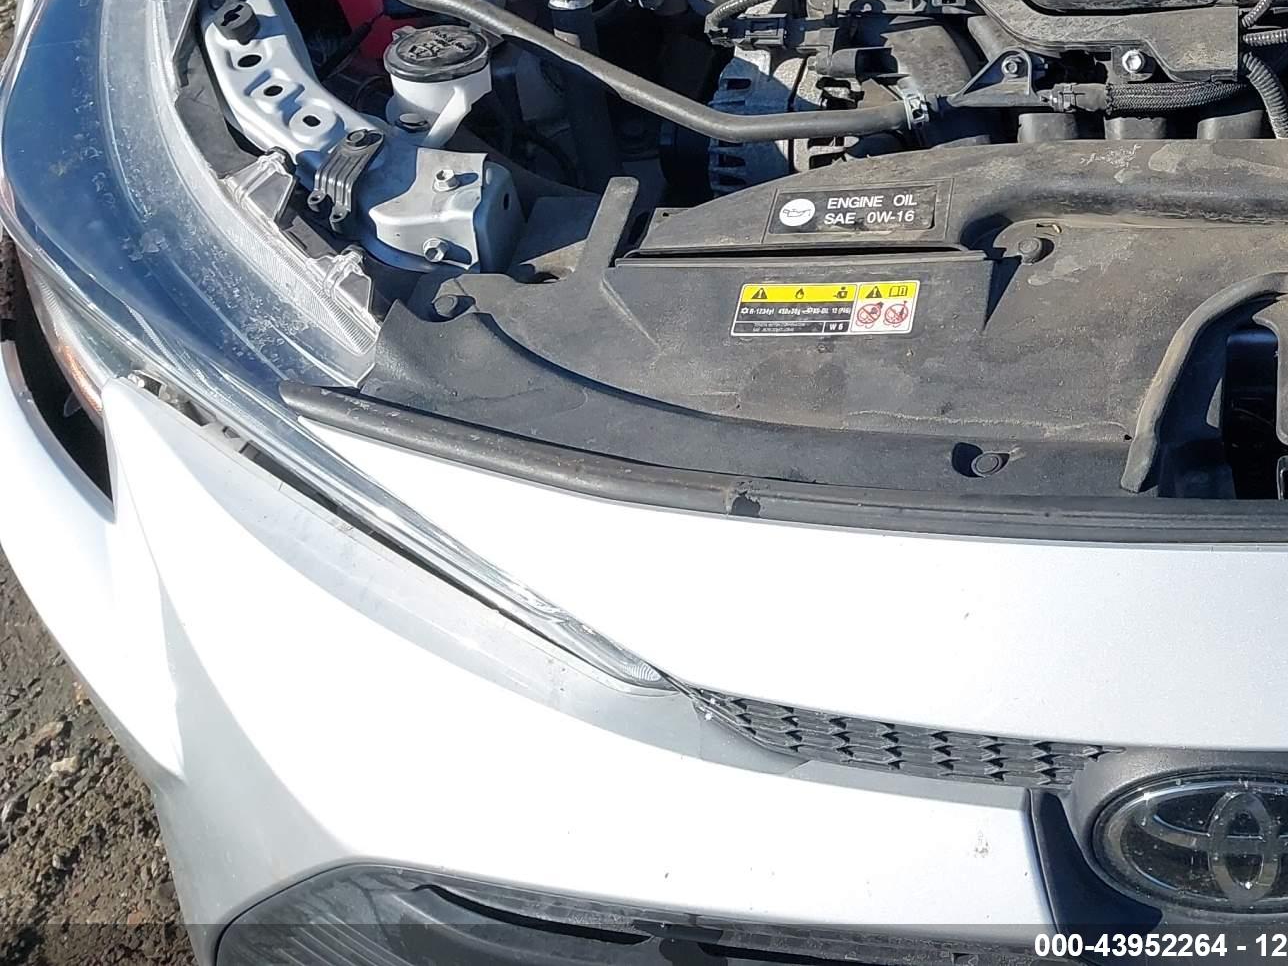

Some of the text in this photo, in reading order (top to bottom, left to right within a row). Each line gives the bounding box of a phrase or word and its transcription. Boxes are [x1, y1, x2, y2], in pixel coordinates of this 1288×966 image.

[827, 194, 918, 209] ENGINE OIL
[824, 210, 915, 224] SAE 0W-16
